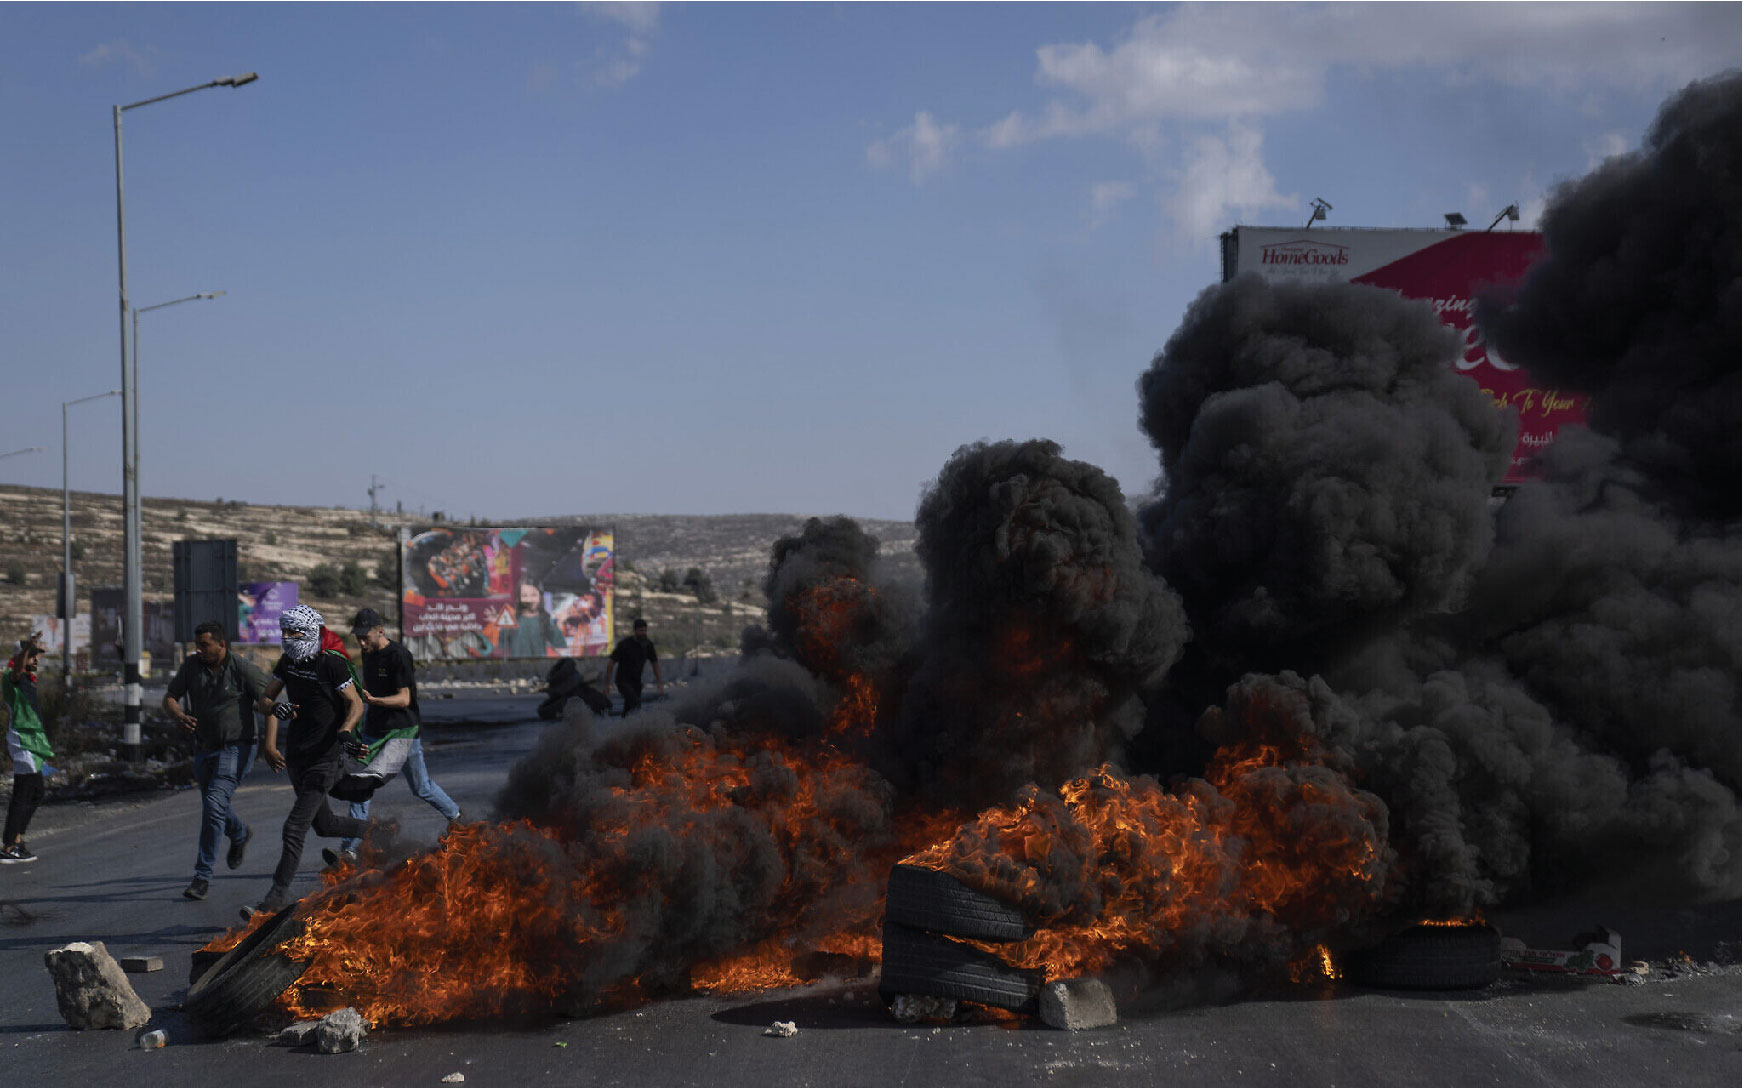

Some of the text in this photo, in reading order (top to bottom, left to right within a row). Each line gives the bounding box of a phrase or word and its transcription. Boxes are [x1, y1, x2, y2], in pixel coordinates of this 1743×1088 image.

[1262, 247, 1349, 265] HomeGoods
[1512, 388, 1543, 415] To
[1541, 387, 1574, 418] Your
